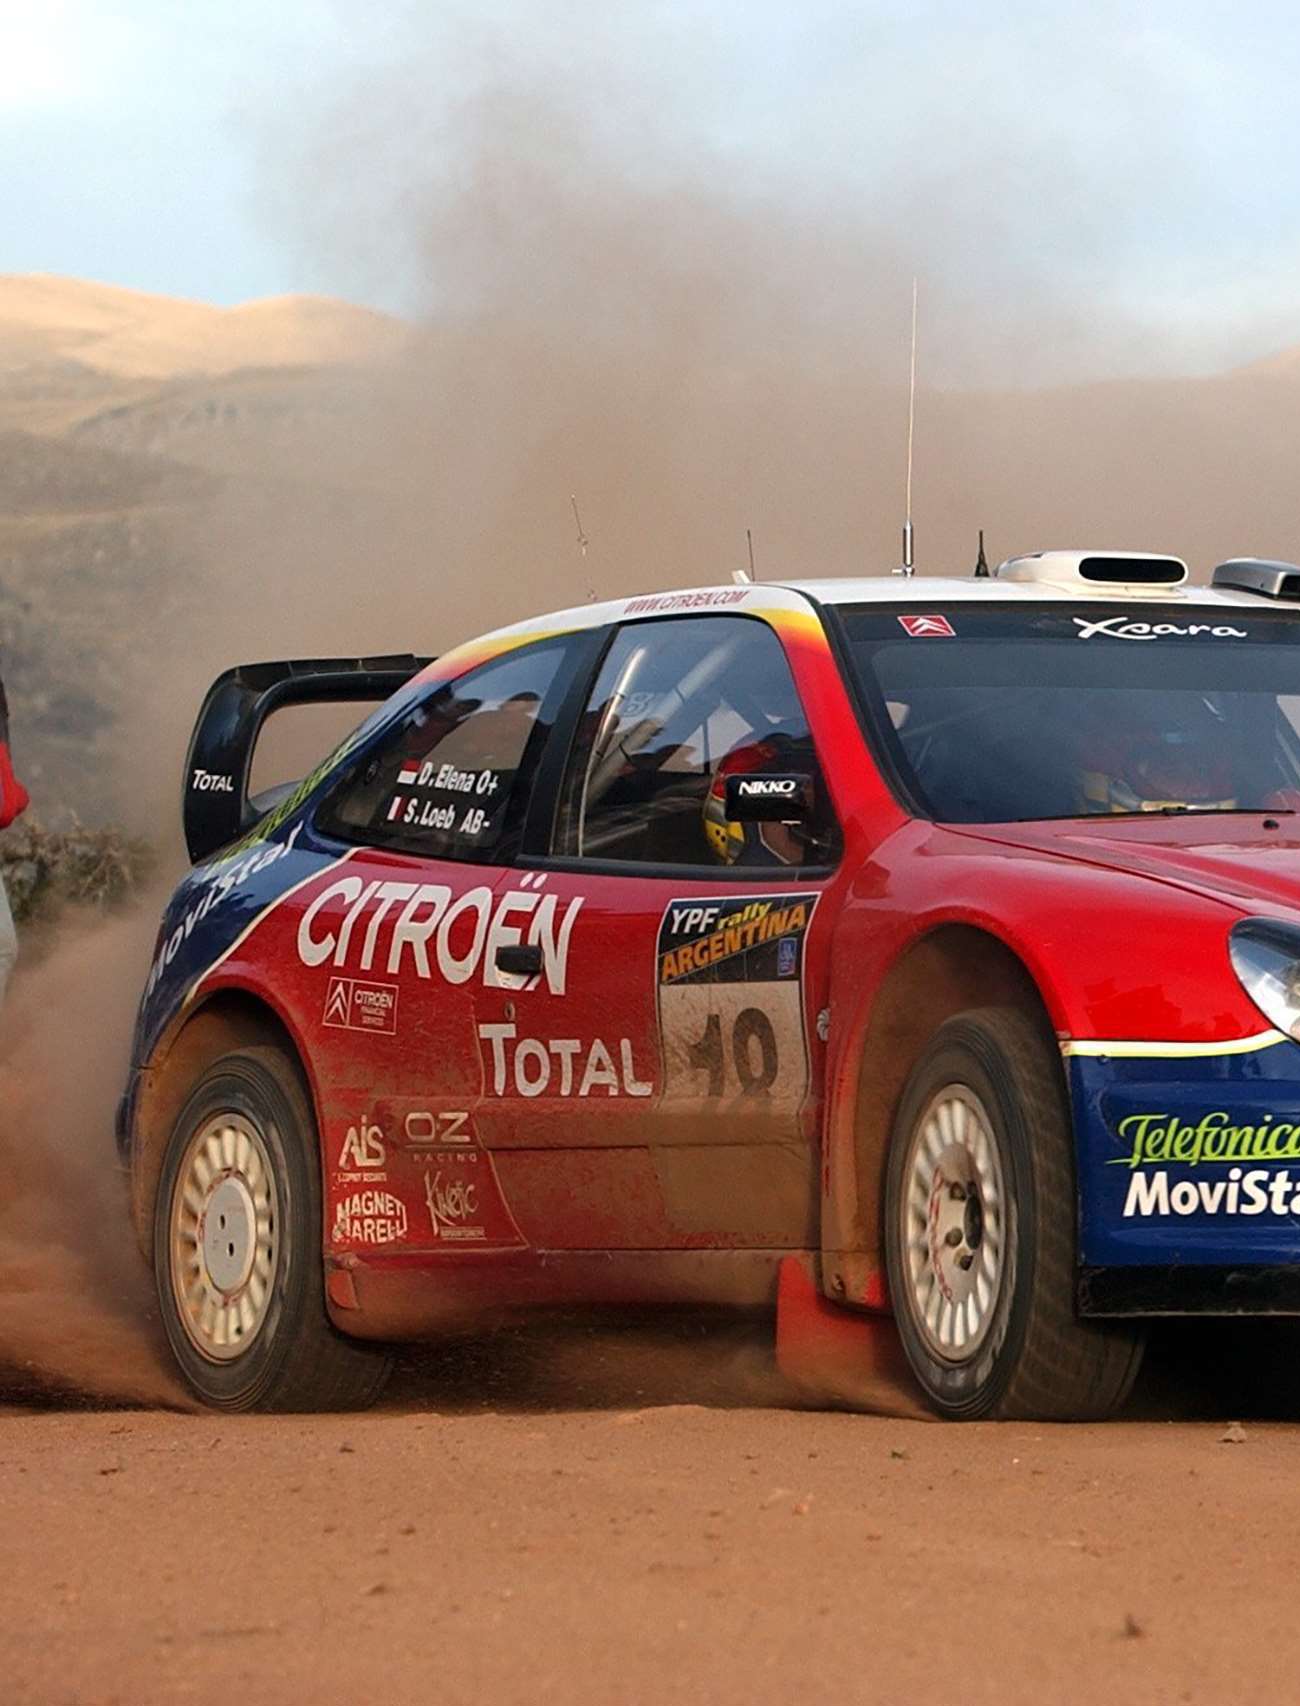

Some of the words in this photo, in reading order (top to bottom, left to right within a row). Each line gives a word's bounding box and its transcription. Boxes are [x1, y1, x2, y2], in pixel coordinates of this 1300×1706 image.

[1072, 616, 1248, 640] Xsara
[476, 769, 499, 796] O+
[738, 780, 797, 796] NIKKO
[460, 807, 491, 835] AB-
[297, 871, 585, 996] CITROËN
[670, 907, 721, 935] YPF
[717, 902, 774, 930] rally
[662, 903, 807, 982] ARGENTINA
[478, 1023, 654, 1098] TOTAL
